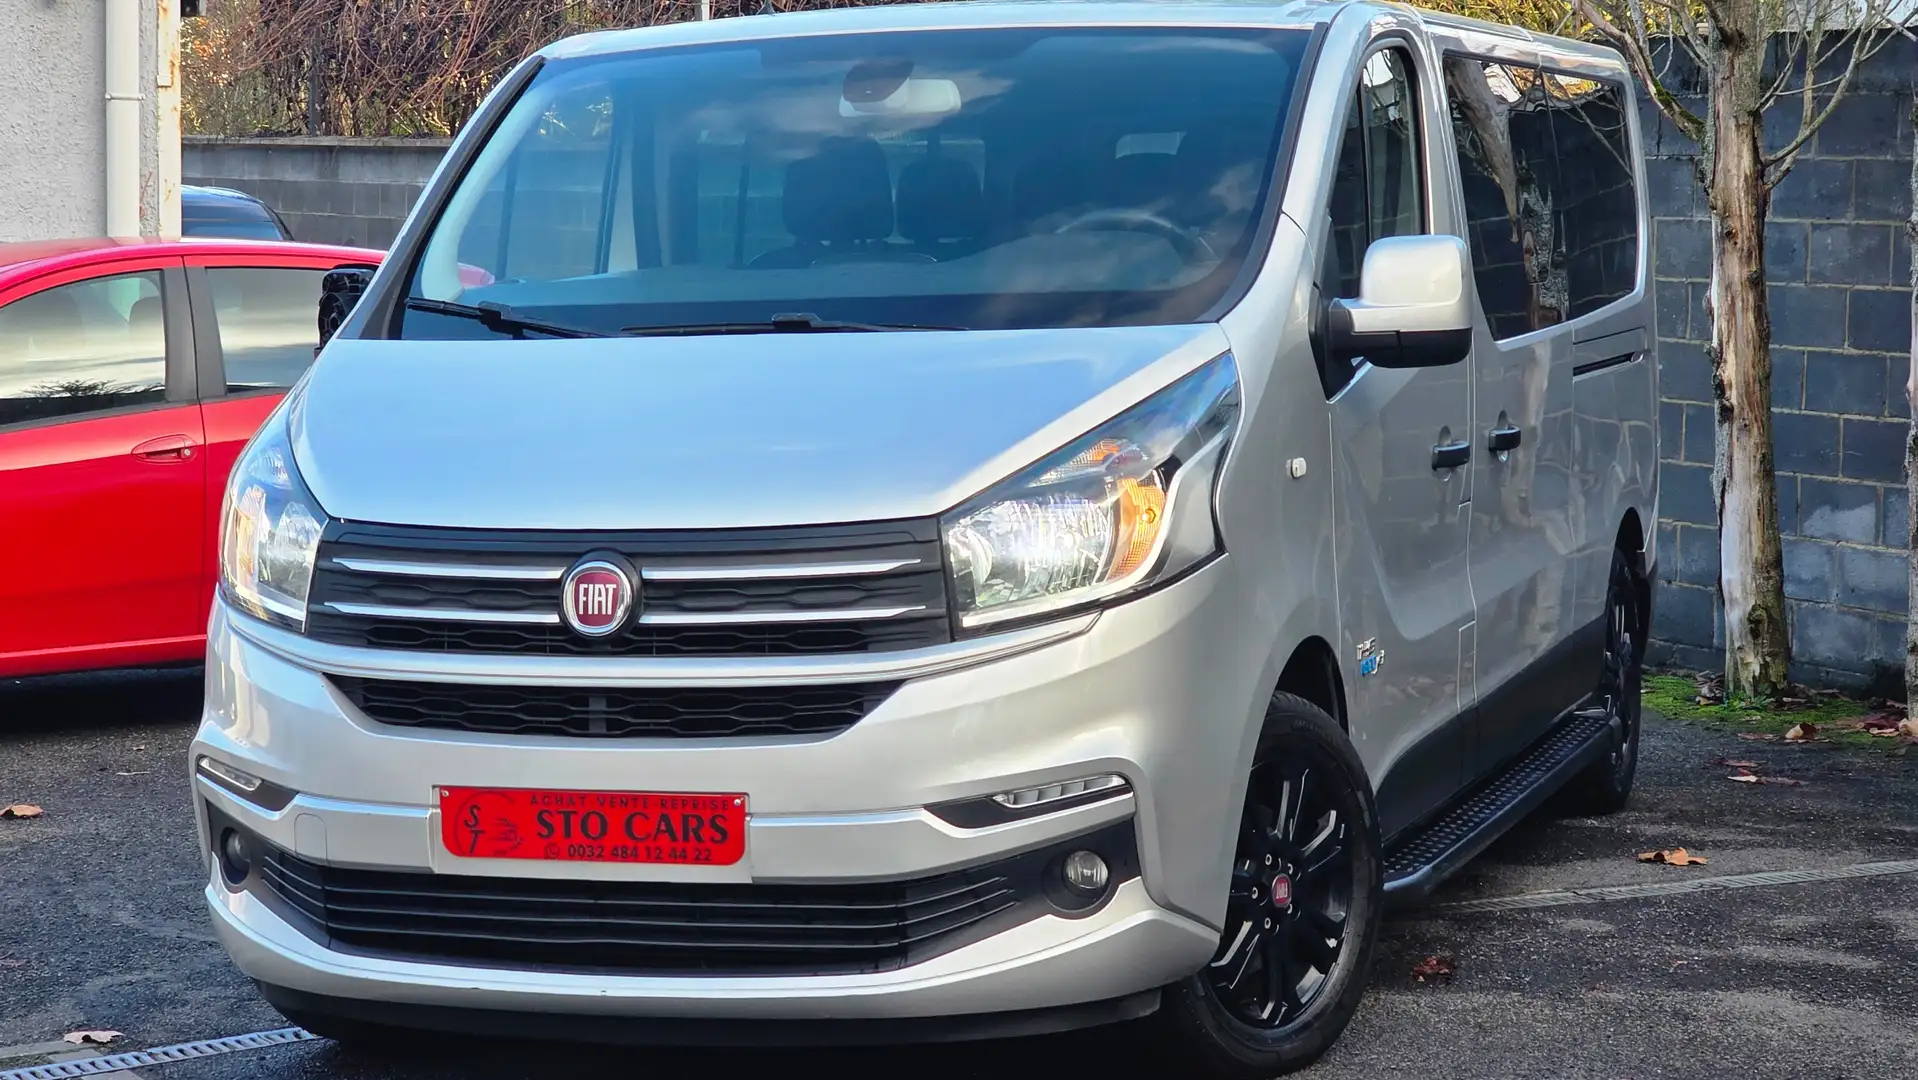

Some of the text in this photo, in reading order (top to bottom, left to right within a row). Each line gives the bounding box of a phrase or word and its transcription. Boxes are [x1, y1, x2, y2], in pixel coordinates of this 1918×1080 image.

[578, 583, 617, 616] FIAT
[530, 794, 729, 810] ACHAT VENTE REPRISE
[536, 808, 728, 845] STO CARS
[568, 843, 712, 862] 0032 484 12 44 22
